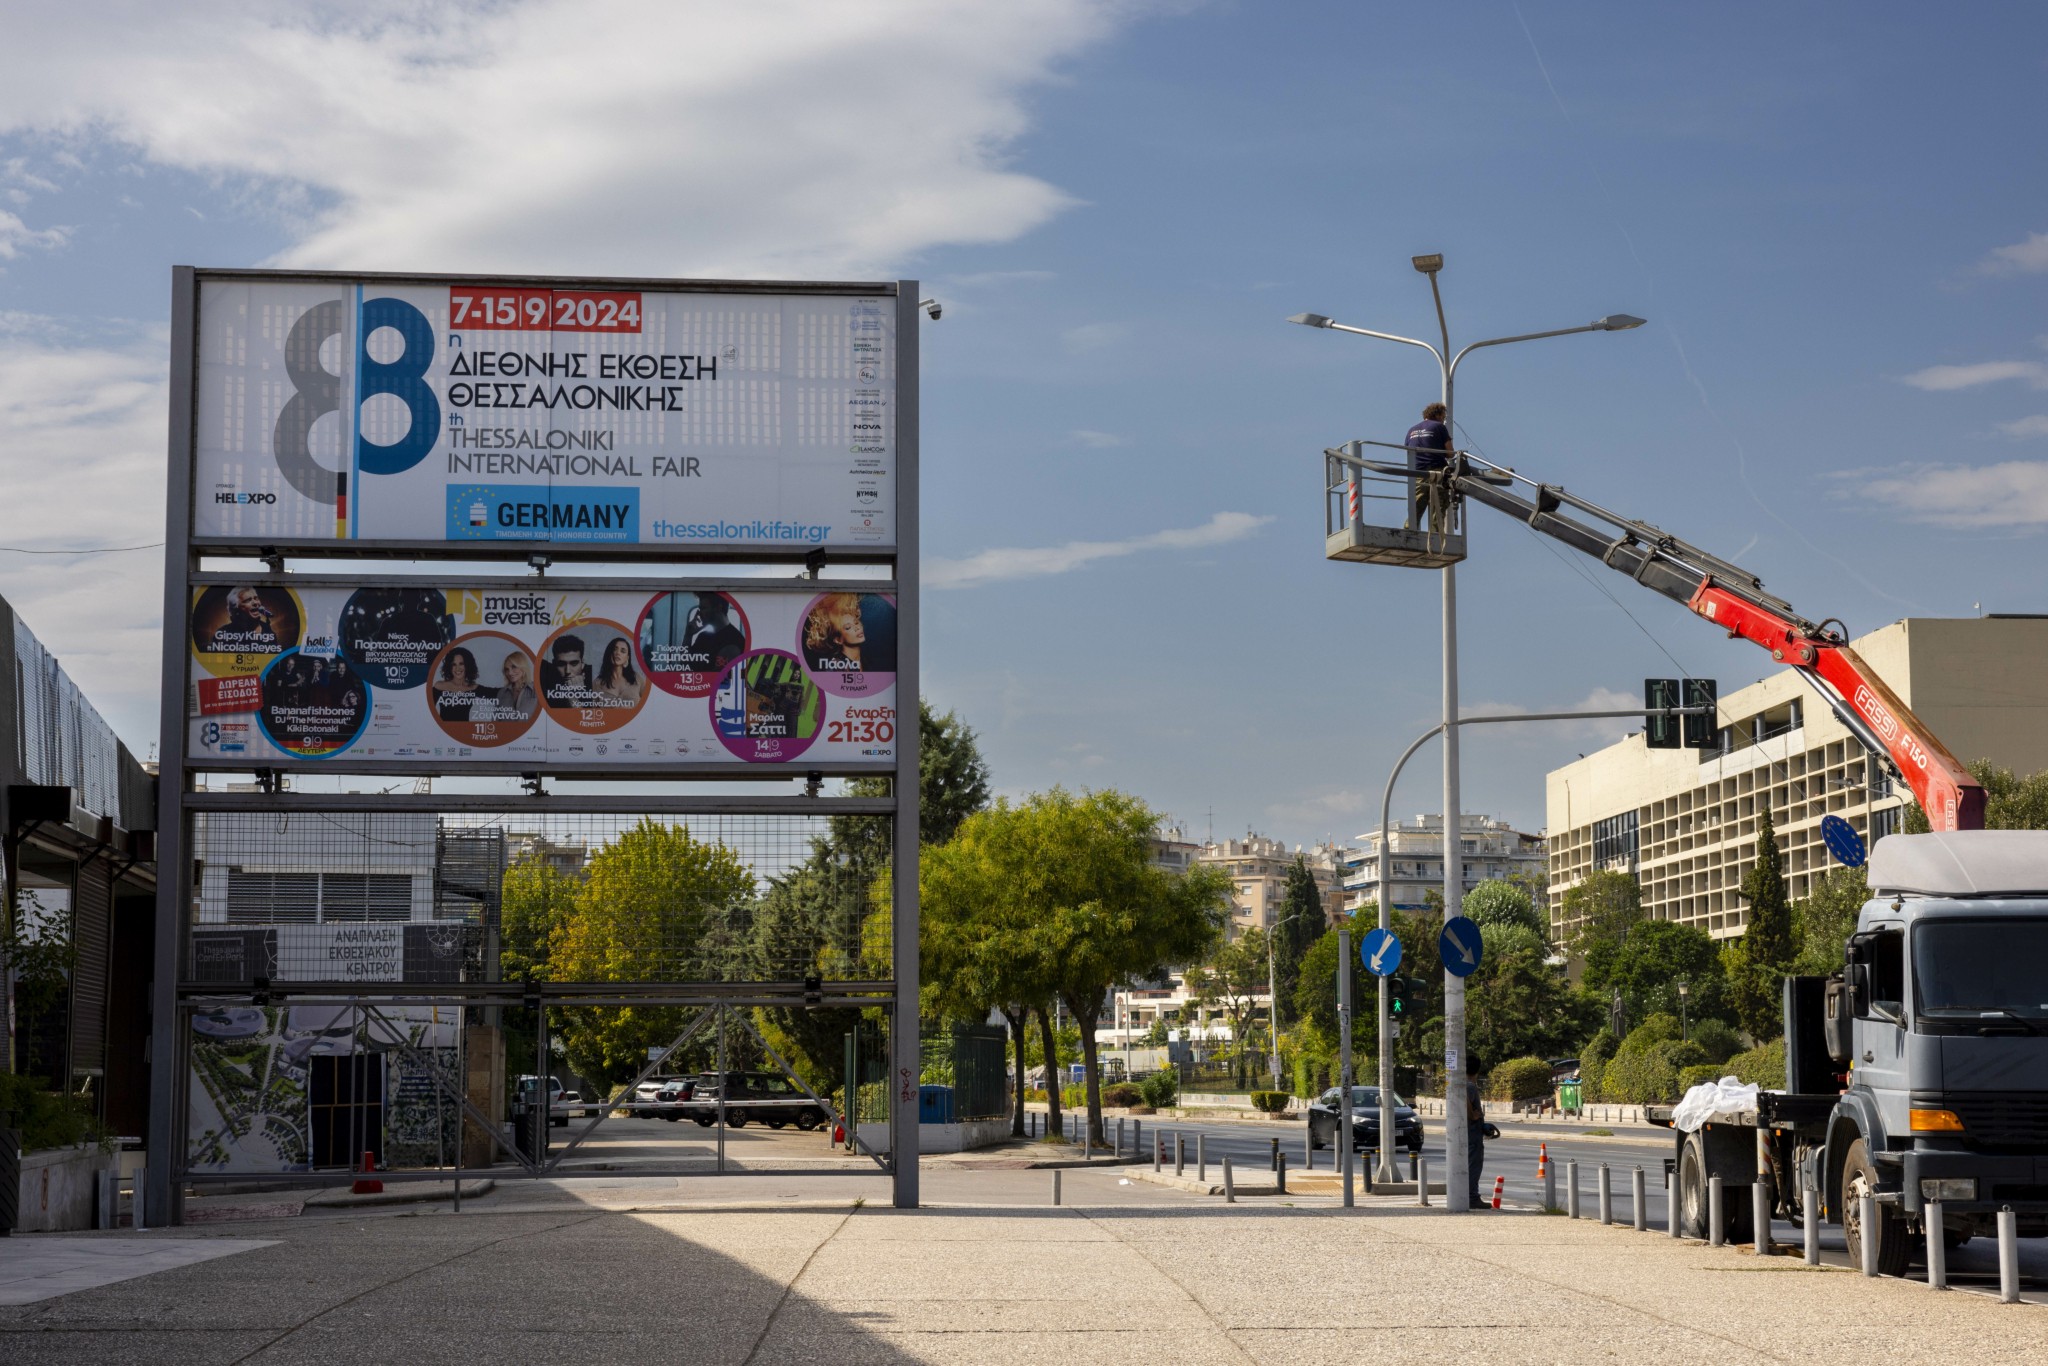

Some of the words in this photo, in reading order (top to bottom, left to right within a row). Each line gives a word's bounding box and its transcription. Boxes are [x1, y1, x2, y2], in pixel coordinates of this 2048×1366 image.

[449, 351, 588, 378] ΔΙΕΘΝΗΣ
[600, 354, 717, 380] ΕΚΘΕΣΗ
[448, 382, 684, 412] ΘΕΣΣΑΛΟΝΙΚΗΣ
[449, 412, 464, 426] th
[449, 428, 614, 451] THESSALONIKI
[448, 453, 643, 477] INTERNATIONAL
[652, 456, 702, 477] FAIR
[215, 493, 277, 504] HELEXPO
[497, 502, 630, 529] GERMANY
[495, 530, 533, 539] ΤΙΜΩΜΕΝΗ
[533, 531, 553, 539] ΧΩΡΑ
[557, 532, 592, 540] HONORED
[593, 532, 627, 540] COUNTRY
[653, 520, 832, 543] thessalonikifair.gr
[484, 592, 546, 611] music
[484, 610, 551, 625] events
[550, 594, 591, 627] live
[215, 631, 245, 642] Gipsy
[245, 631, 275, 642] Kings
[388, 633, 409, 641] Νίκος
[212, 641, 250, 652] Nicolas
[251, 643, 282, 654] Reyes
[354, 639, 442, 651] Πορτοκάλογλου
[656, 644, 689, 653] Γιώργος
[650, 651, 710, 663] Σαμπάνης
[819, 657, 861, 669] Πάολα
[231, 665, 260, 673] ΚΥΡΙΑΚΗ
[218, 677, 257, 690] ΔΩΡΕΑΝ
[555, 684, 587, 692] Γιώργος
[674, 683, 711, 691] ΠΑΡΑΣΚΕΥΗ
[217, 687, 259, 699] ΕΙΣΟΔΟΣ
[547, 689, 605, 699] Κακοσαίος
[437, 695, 499, 706] Αρβανιτάκη
[572, 700, 604, 708] Χριστίνα
[604, 698, 635, 709] Σάλτη
[271, 705, 355, 716] Bananafishbones
[472, 709, 529, 721] Ζουγανέλη
[845, 706, 896, 721] έναρξη
[1857, 689, 1895, 737] FASSI
[275, 716, 287, 724] DJ
[749, 713, 785, 722] Μαρίνα
[303, 725, 339, 733] Botonaki
[749, 722, 787, 735] Σάττι
[827, 721, 895, 743] 21:30
[754, 751, 782, 759] ΣΑΒΒΑΤΟ
[335, 929, 396, 943] ΑΝΑΠΛΑΣΗ
[329, 945, 397, 959] ΕΚΘΕΣΙΑΚΟΥ
[346, 961, 397, 975] ΚΕΝΤΡΟΥ
